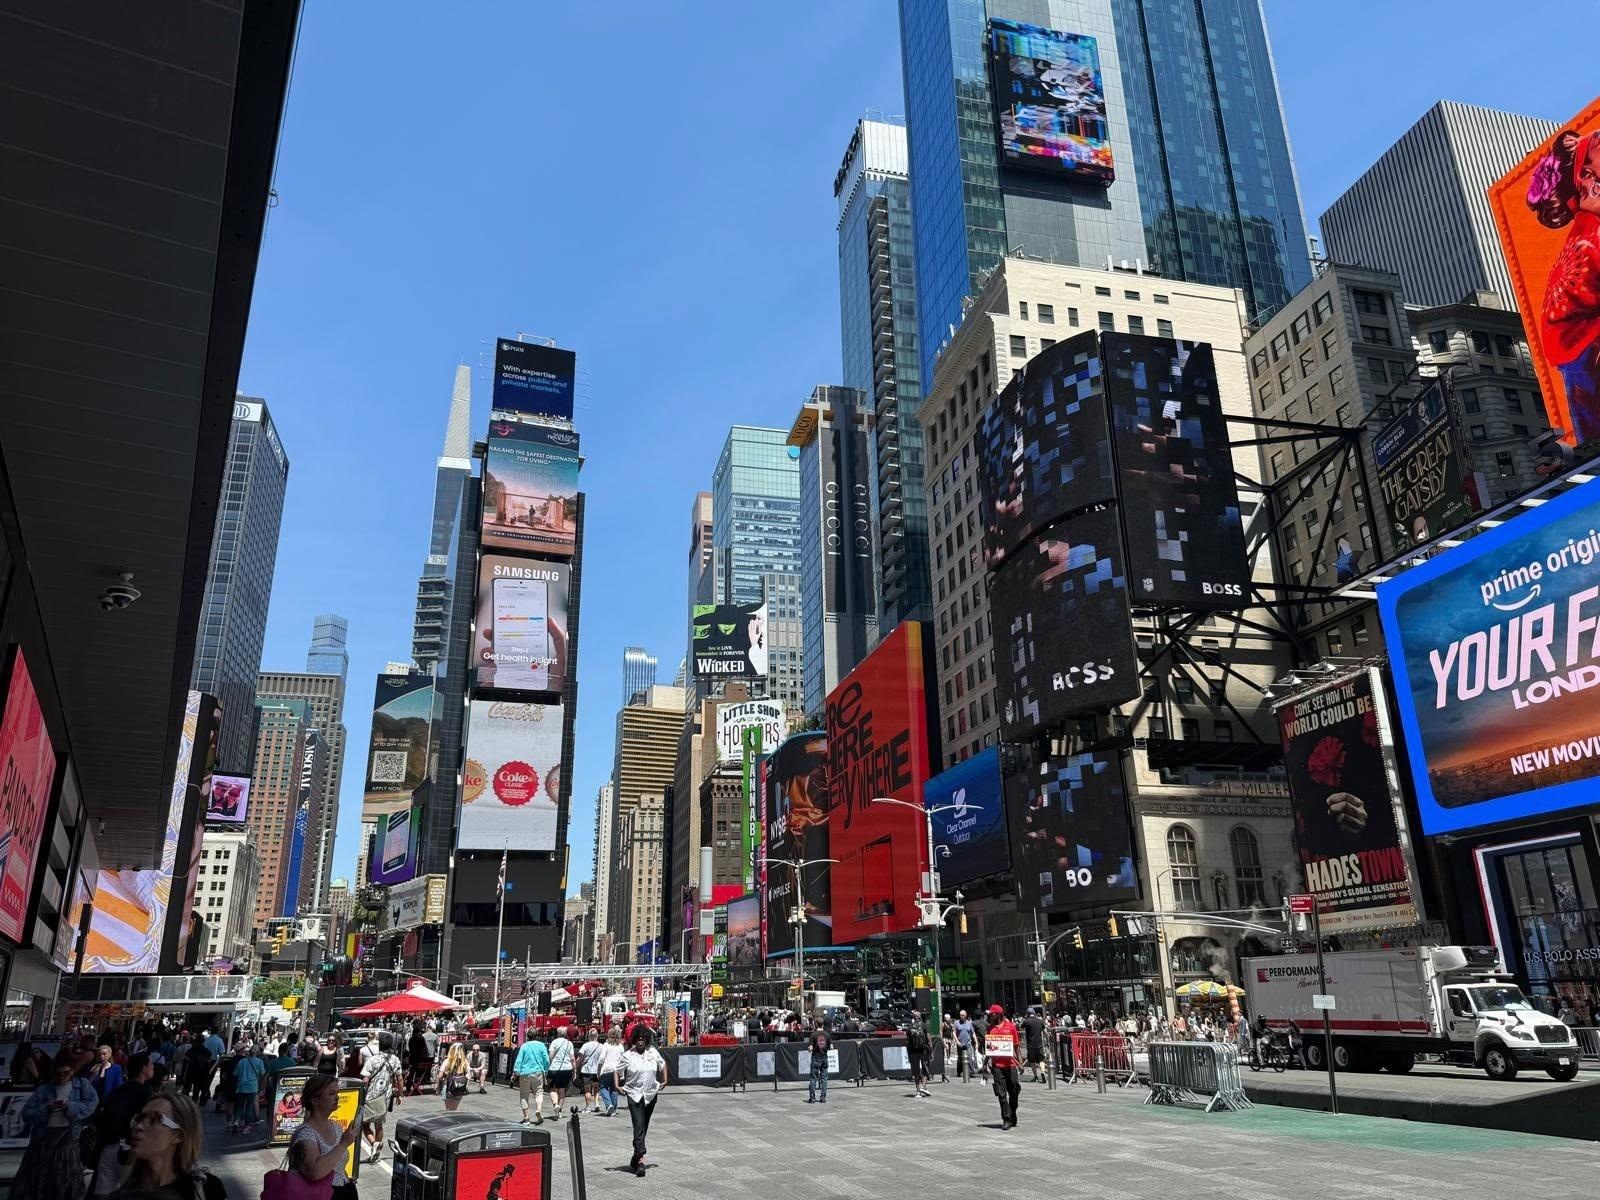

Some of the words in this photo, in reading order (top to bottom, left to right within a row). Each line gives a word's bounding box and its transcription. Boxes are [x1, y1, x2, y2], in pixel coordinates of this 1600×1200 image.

[502, 364, 520, 373] With
[522, 368, 557, 379] expertise
[502, 372, 527, 381] across
[528, 377, 551, 386] public
[501, 379, 529, 388] private
[1381, 467, 1407, 505] THE
[1406, 425, 1453, 484] GREAT
[1394, 459, 1447, 521] GATSBY
[825, 481, 841, 555] GUCCI
[493, 565, 560, 581] SAMSUNG
[1480, 561, 1543, 606] prime
[1546, 529, 1600, 573] origi
[1202, 582, 1242, 596] BOSS
[483, 652, 499, 661] Get
[500, 653, 529, 663] health
[530, 655, 558, 666] insight
[1429, 602, 1557, 710] YOUR
[1293, 700, 1312, 718] COME
[1312, 694, 1325, 711] SEE
[1325, 688, 1340, 706] HOW
[1341, 682, 1356, 700] THE
[723, 704, 756, 724] LITTLE
[757, 703, 781, 720] SHOP
[1284, 713, 1319, 739] WORLD
[1320, 701, 1355, 727] COULD
[1356, 695, 1373, 715] BE
[723, 722, 780, 754] HORS
[1510, 749, 1550, 776] NEW
[499, 770, 529, 782] Coke
[748, 750, 756, 867] CANNABIS
[946, 822, 958, 835] Clear
[958, 813, 977, 830] Channel
[953, 831, 971, 845] Outdoor
[1315, 890, 1348, 901] OADWAY'S
[1347, 885, 1372, 896] GLOBAL
[1523, 952, 1543, 963] U.S.
[1543, 949, 1573, 962] POLO
